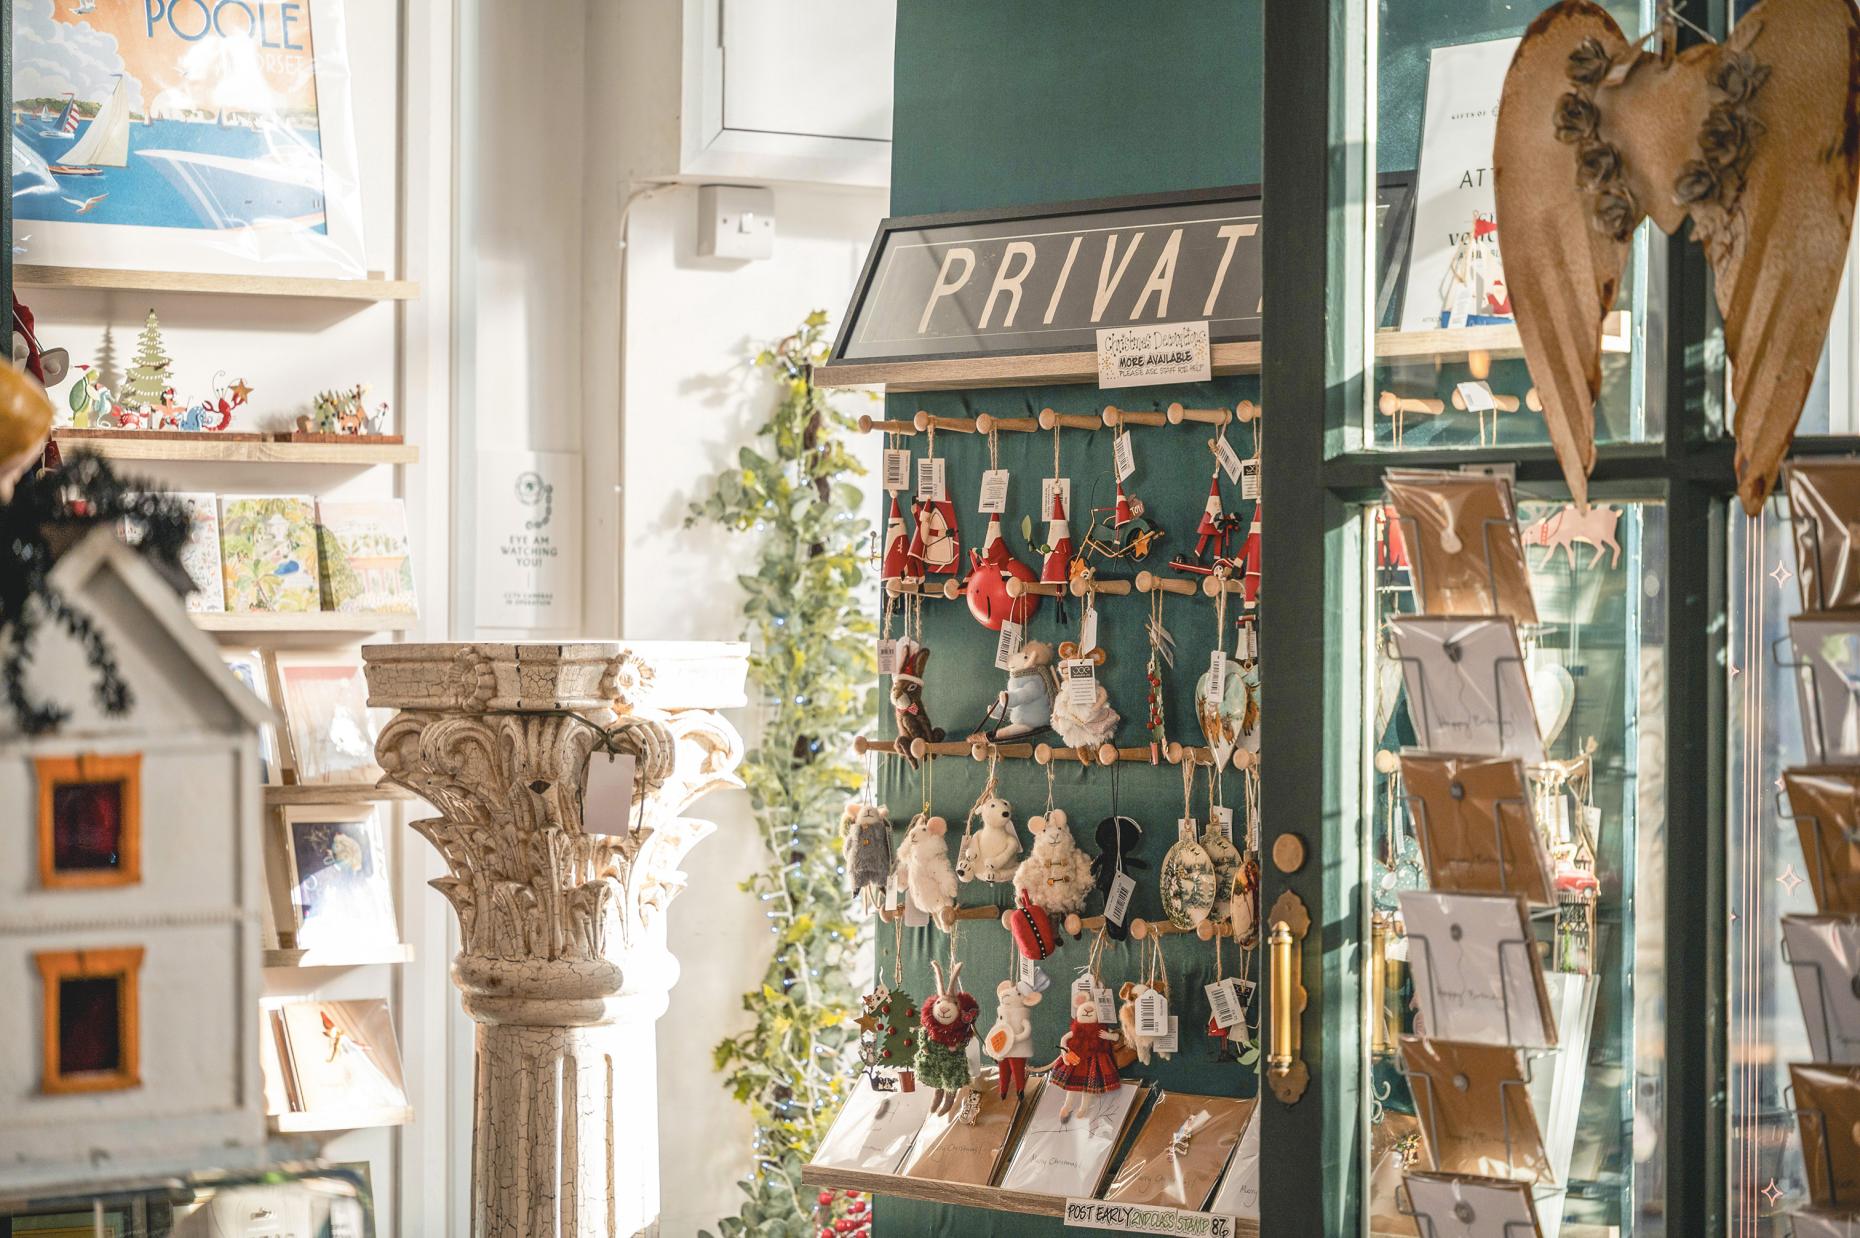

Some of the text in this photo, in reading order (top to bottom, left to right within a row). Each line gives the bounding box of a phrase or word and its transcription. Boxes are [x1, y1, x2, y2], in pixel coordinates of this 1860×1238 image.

[145, 0, 304, 50] POOLE
[917, 223, 1262, 334] PRIVAT
[1119, 350, 1193, 368] MORE AVAILABLE
[1119, 369, 1144, 378] PLEASE
[533, 535, 550, 545] AM
[500, 546, 558, 558] WATCHING
[1068, 1204, 1095, 1220] POST
[1096, 1206, 1133, 1227] EARLY
[1131, 1211, 1151, 1226] 2ND
